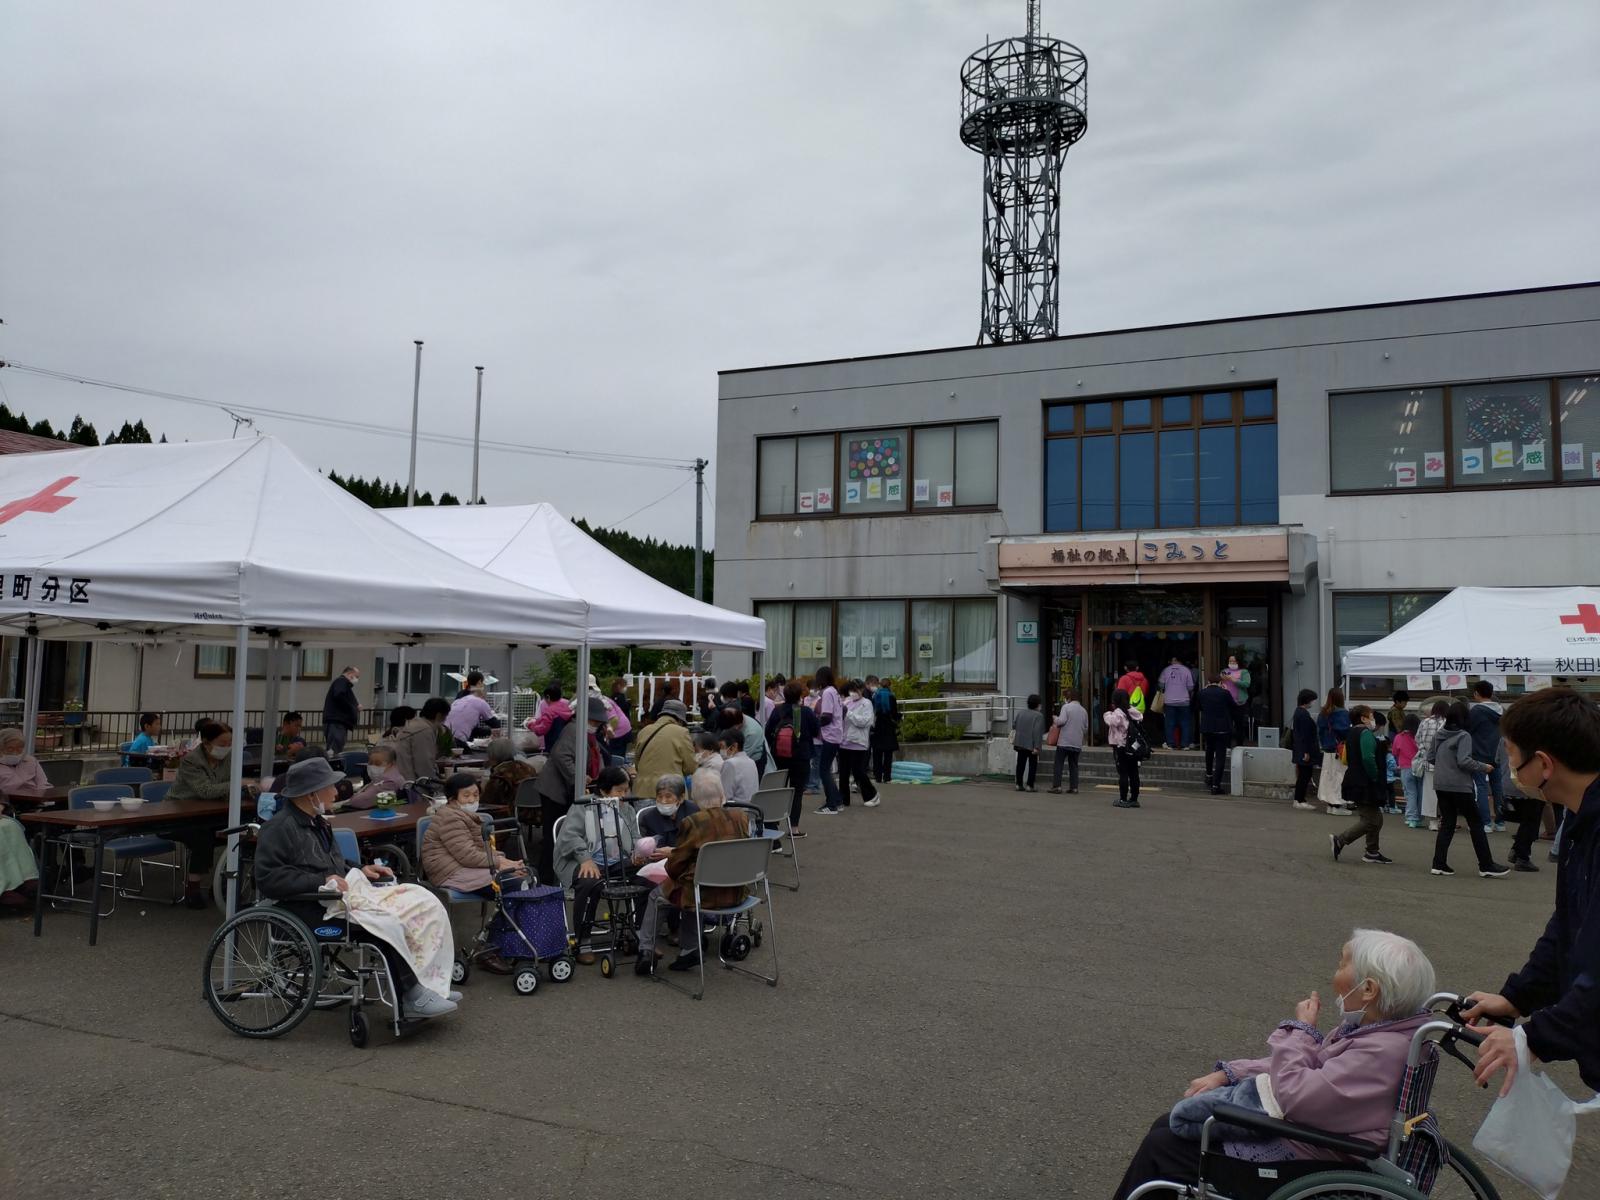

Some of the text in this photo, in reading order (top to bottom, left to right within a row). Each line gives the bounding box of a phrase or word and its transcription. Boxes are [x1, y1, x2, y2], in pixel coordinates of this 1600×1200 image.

[1051, 540, 1228, 564] 福祉の拠点 こみっと
[0, 574, 91, 603] 町分区
[1420, 657, 1600, 672] 日本赤十字社 秋田
